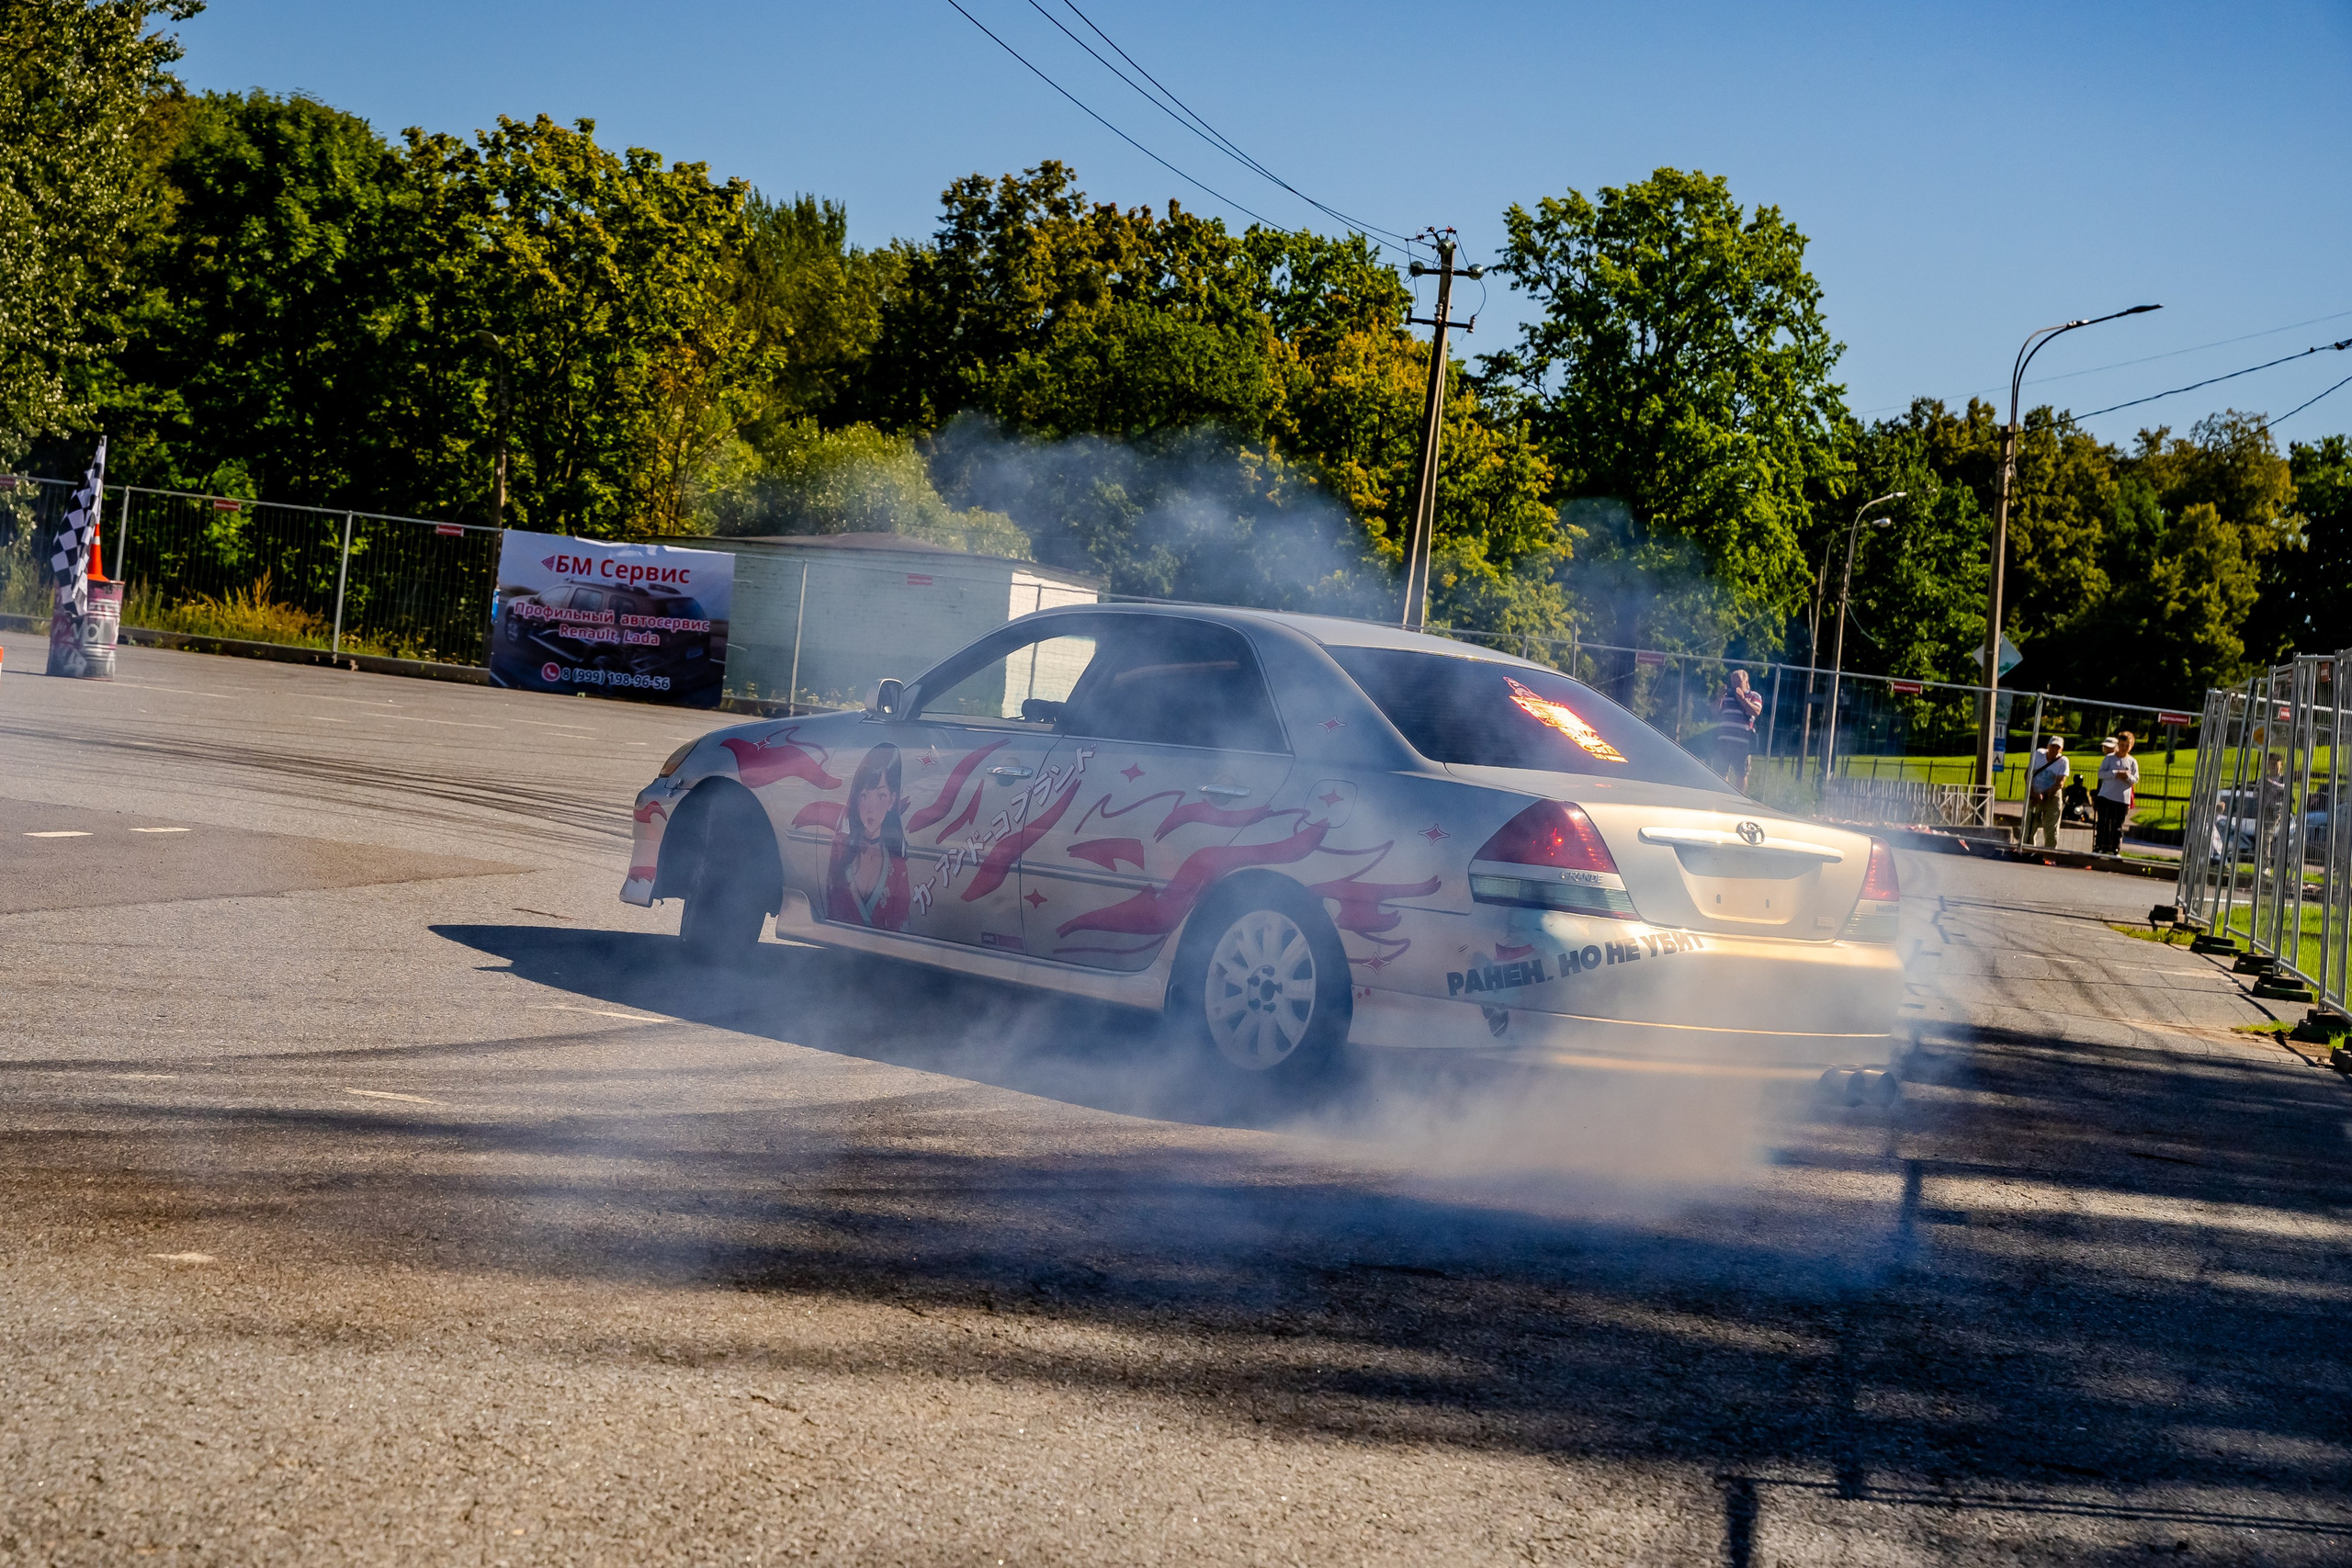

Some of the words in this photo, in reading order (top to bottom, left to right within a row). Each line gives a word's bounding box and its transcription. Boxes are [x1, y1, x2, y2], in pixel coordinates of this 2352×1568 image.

[556, 555, 592, 576] БМ
[600, 558, 691, 585] Сервис
[514, 602, 615, 624] Профильный
[620, 614, 710, 633] автосервис
[560, 624, 620, 645] Renault,
[623, 630, 660, 646] Lada
[561, 669, 570, 681] 8
[572, 670, 605, 684] (999)
[608, 672, 671, 691] 198-96-56
[1559, 870, 1604, 884] GRANDE
[1558, 944, 1601, 977] НО
[1605, 937, 1641, 965] НЕ
[1639, 931, 1704, 958] УБИТ
